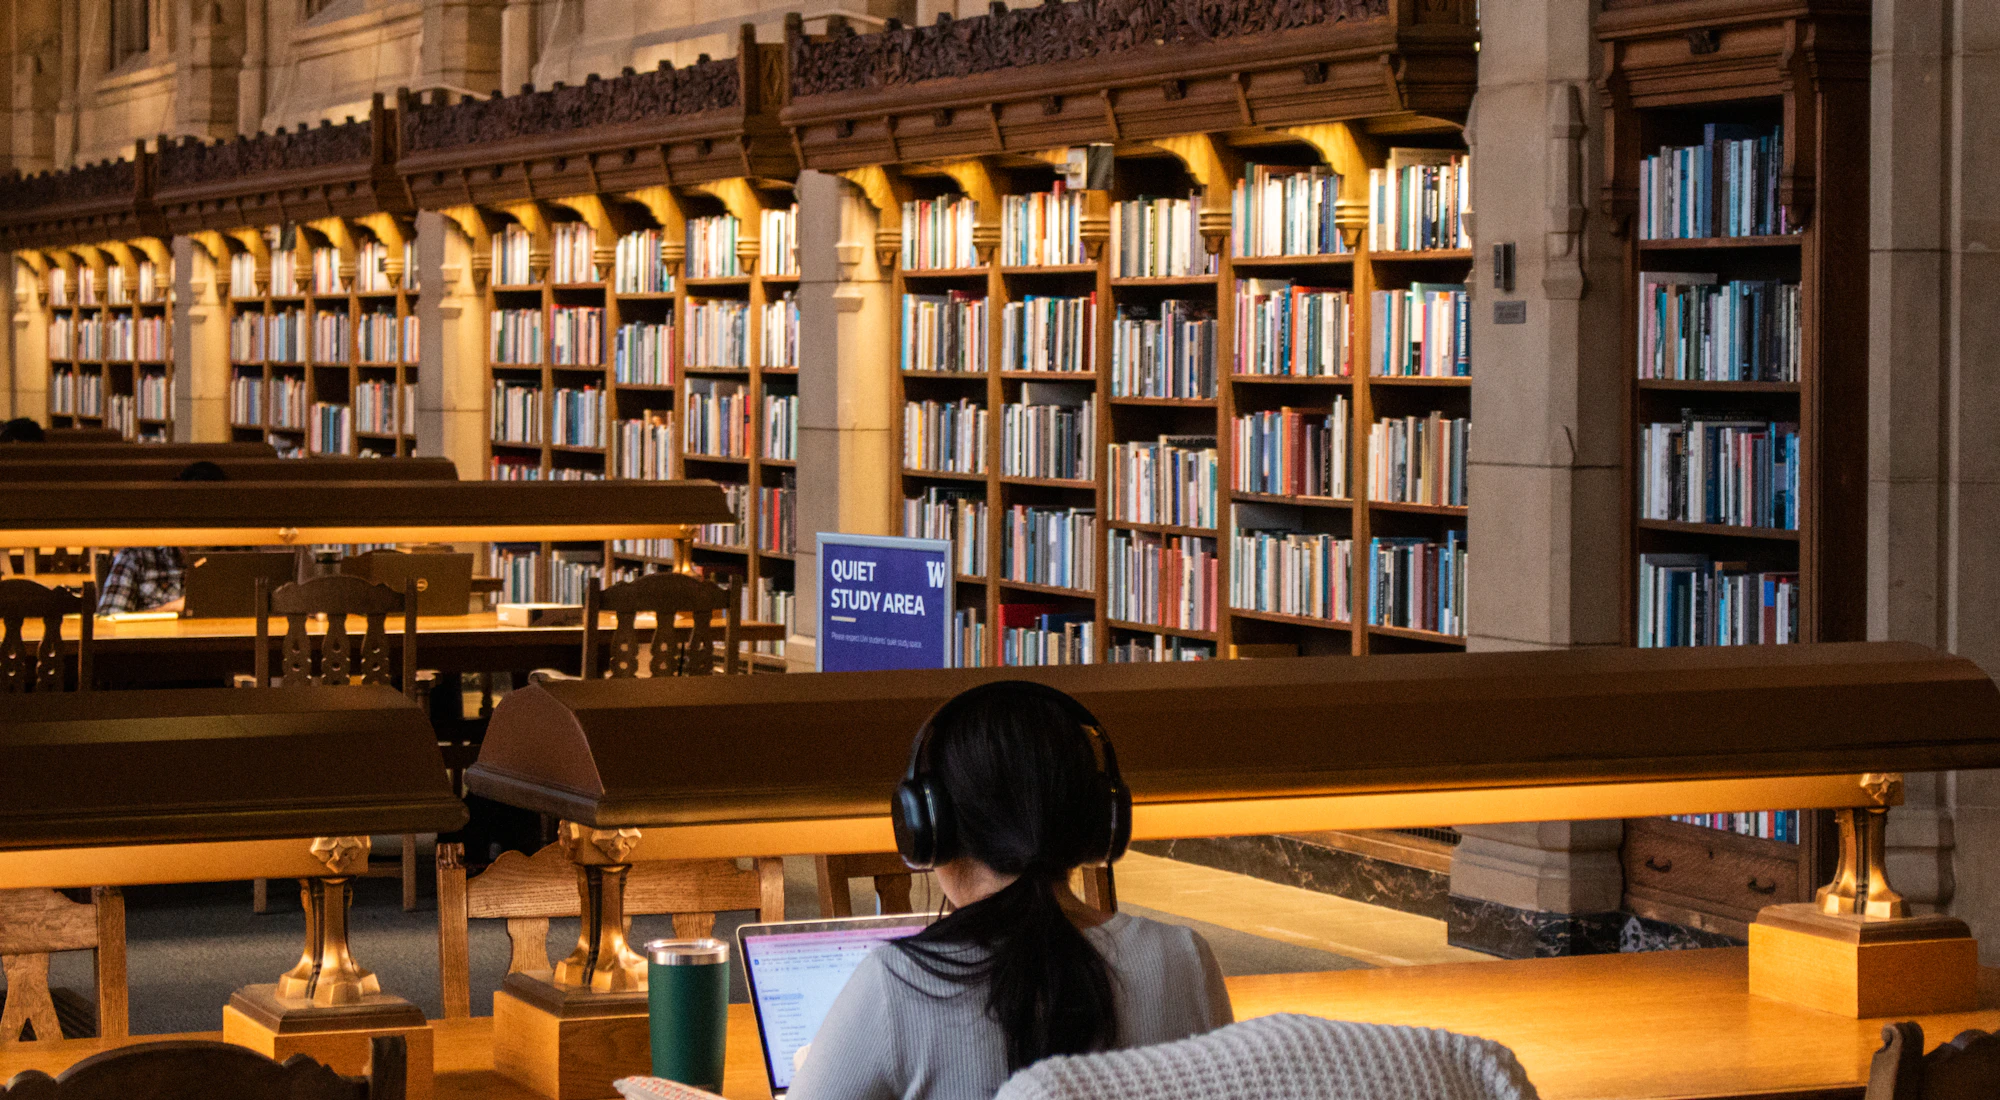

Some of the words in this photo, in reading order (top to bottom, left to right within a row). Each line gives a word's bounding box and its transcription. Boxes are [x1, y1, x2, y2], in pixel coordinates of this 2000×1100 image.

[831, 559, 877, 583] QUIET
[926, 561, 945, 588] W
[831, 588, 881, 612] STUDY
[883, 593, 925, 616] AREA
[831, 631, 845, 641] Please
